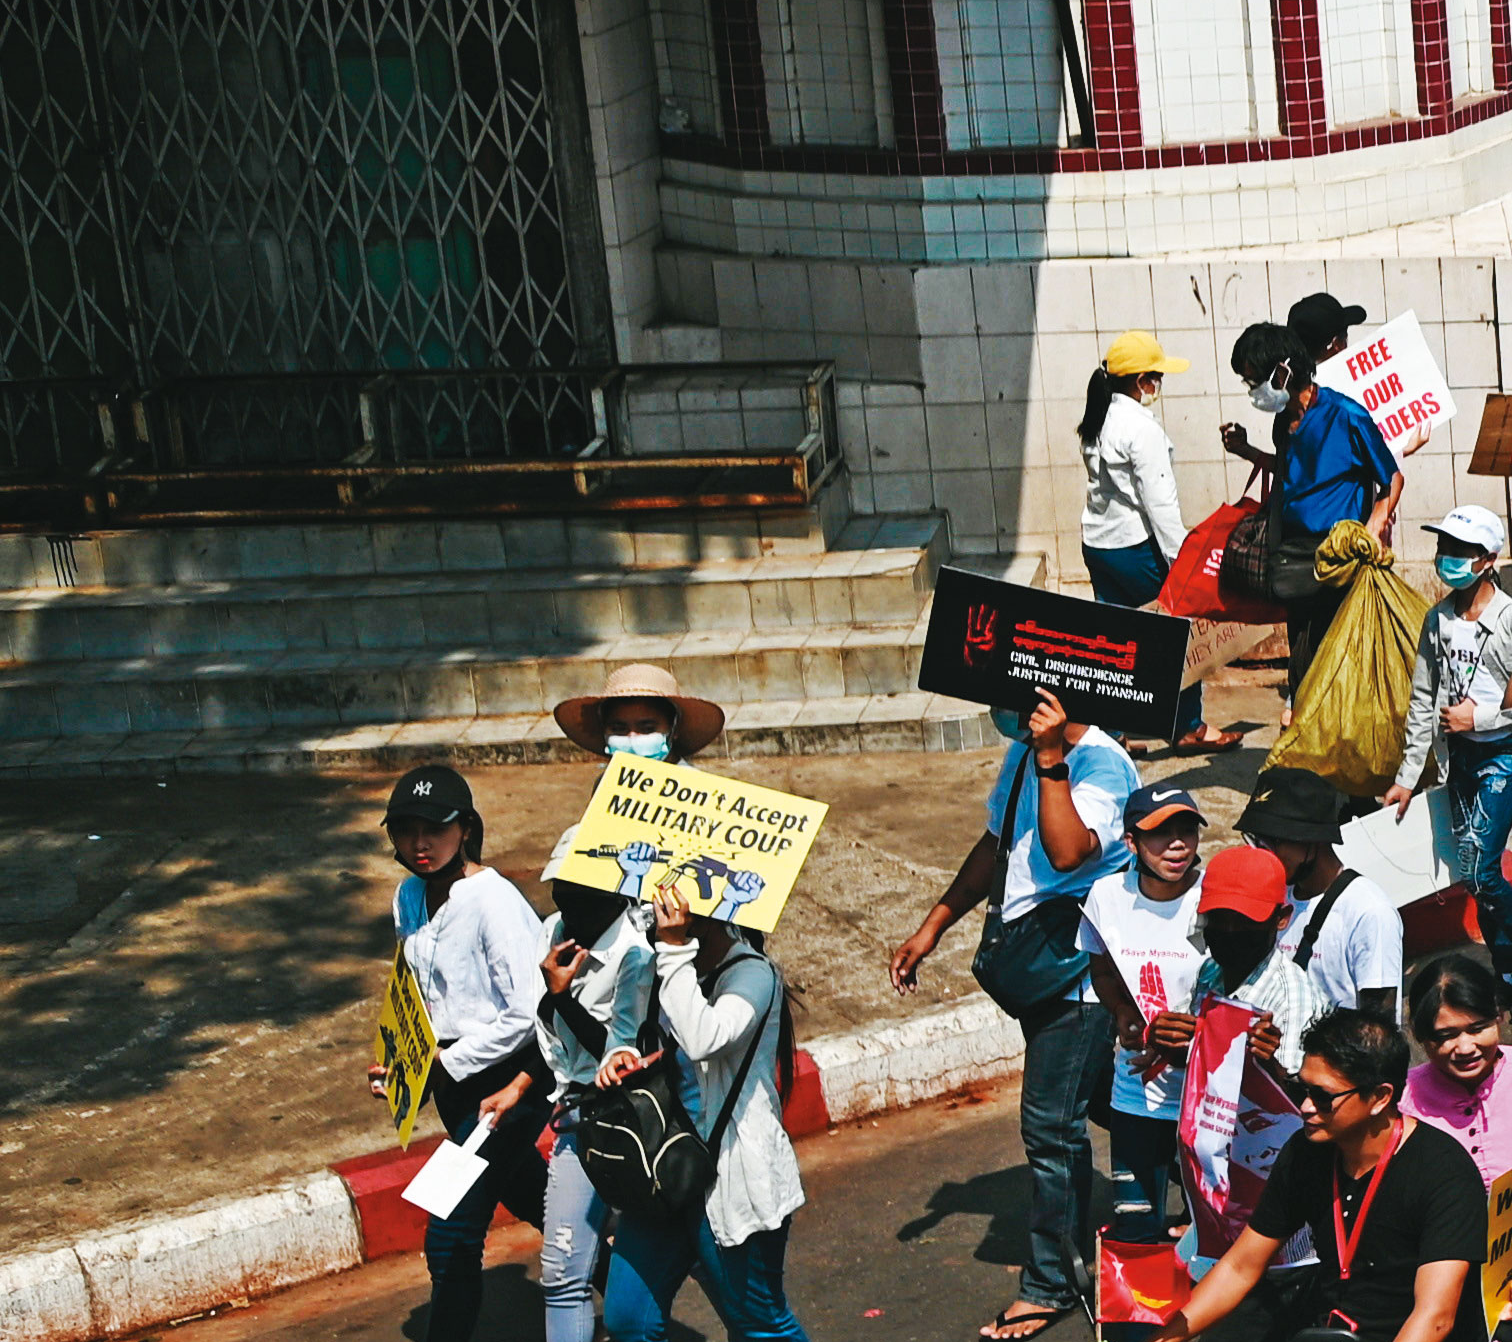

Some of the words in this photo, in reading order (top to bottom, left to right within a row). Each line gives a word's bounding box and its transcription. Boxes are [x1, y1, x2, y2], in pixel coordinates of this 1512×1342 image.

[1346, 337, 1393, 381] FREE
[1362, 373, 1405, 411] OUR
[1008, 667, 1062, 689] JUSTICE
[1065, 677, 1090, 694] FOR
[1095, 682, 1154, 705] MYANMAR
[1010, 650, 1040, 667] CIVIL
[1045, 658, 1135, 685] DISOBEDIENCE
[606, 793, 719, 842] MILITARY
[616, 766, 652, 794] We
[658, 776, 729, 815] Don't
[729, 795, 810, 833] Accept
[1149, 950, 1189, 961] Myanmar
